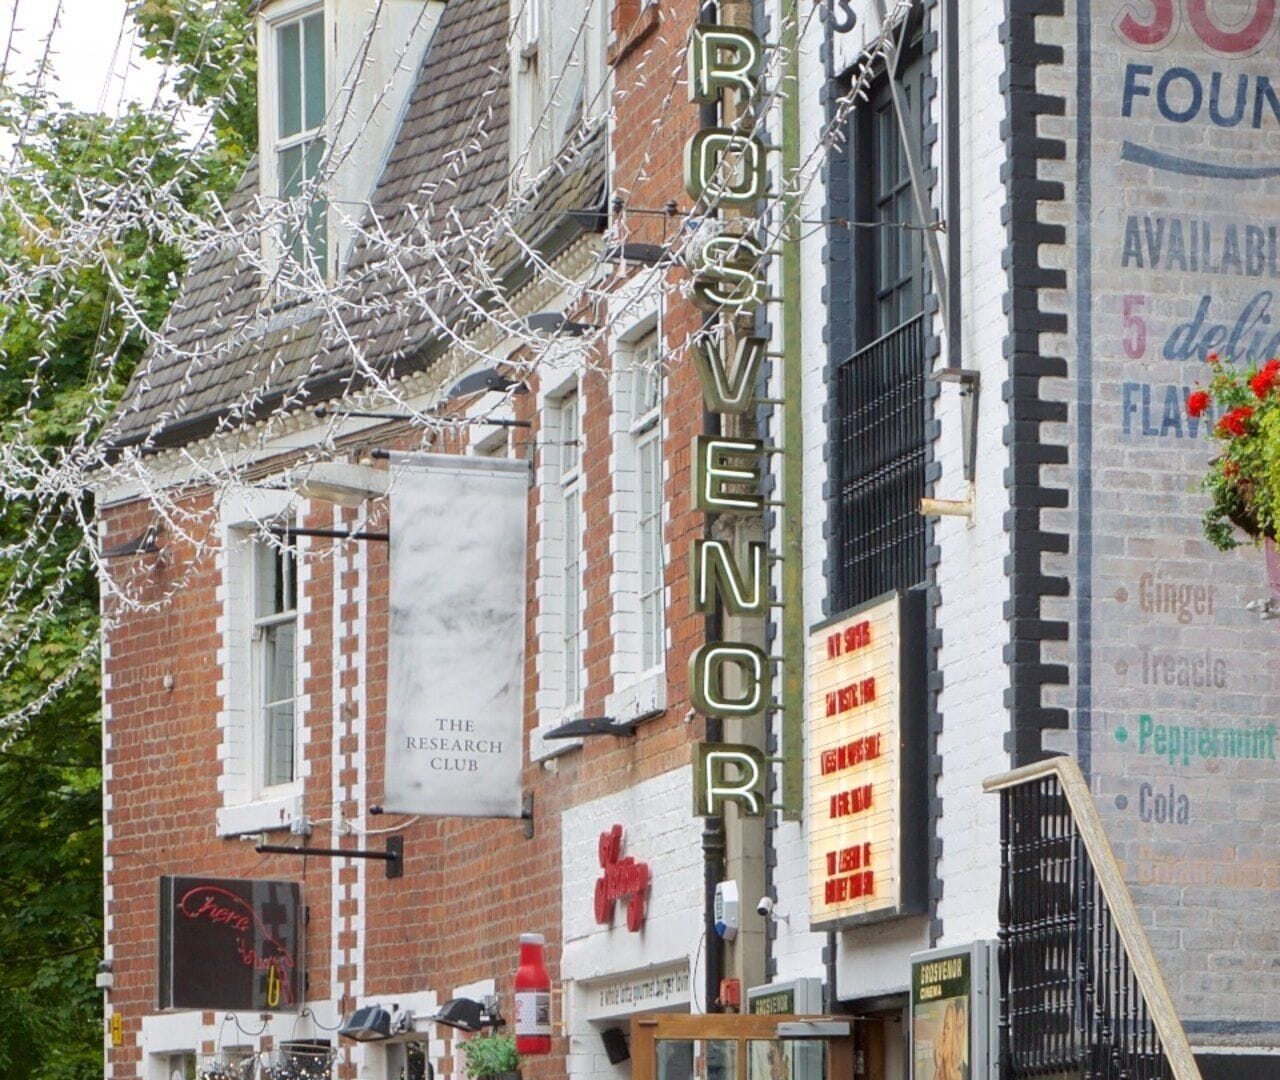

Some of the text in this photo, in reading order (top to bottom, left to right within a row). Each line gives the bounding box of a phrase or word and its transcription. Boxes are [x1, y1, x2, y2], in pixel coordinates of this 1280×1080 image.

[1122, 294, 1146, 360] 5
[686, 24, 770, 818] ROSVENOR
[1139, 572, 1216, 624] Ginger
[1140, 646, 1227, 688] Treacle
[406, 736, 502, 753] RESEARCH
[435, 718, 475, 732] THE
[1139, 714, 1277, 766] Peppermint
[430, 757, 478, 771] CLUB
[1139, 783, 1189, 825] Cola
[920, 957, 962, 985] GROSVENOR
[920, 984, 942, 1000] CINEMA
